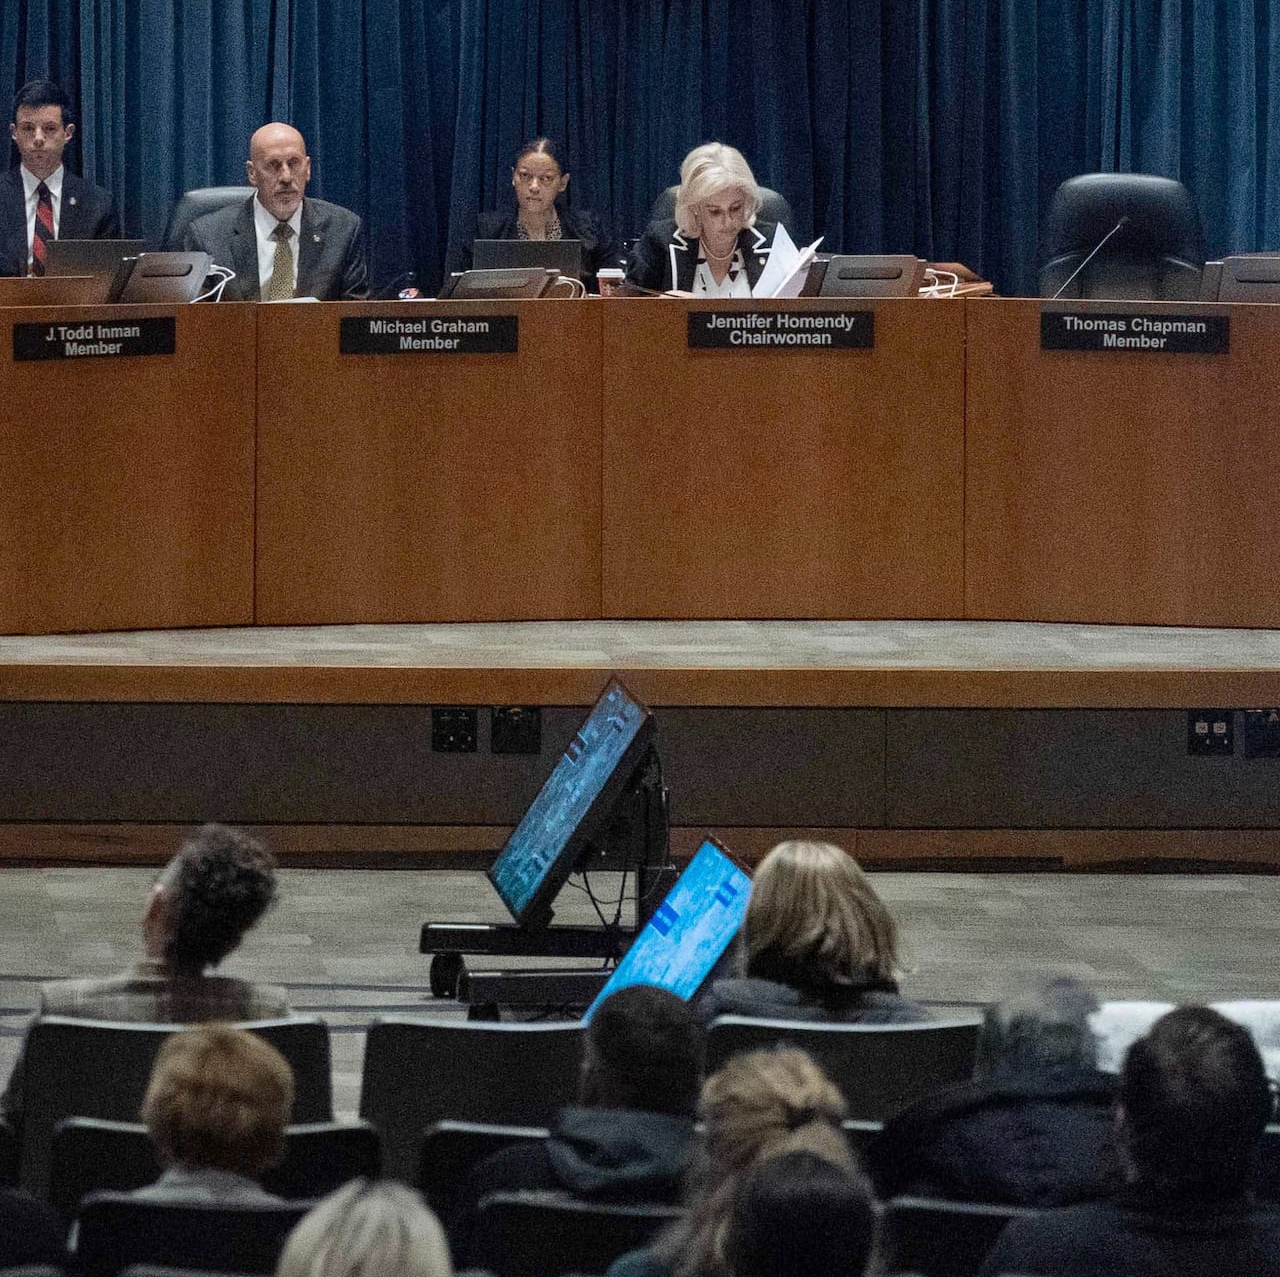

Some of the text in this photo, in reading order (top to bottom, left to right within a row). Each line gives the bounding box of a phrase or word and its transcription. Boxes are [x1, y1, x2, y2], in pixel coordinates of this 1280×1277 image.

[369, 320, 490, 334] Michael Graham
[707, 314, 855, 331] Jennifer Homendy
[1063, 316, 1206, 335] Thomas Chapman
[45, 326, 140, 341] J. Todd Inman
[730, 330, 832, 345] Chairwoman
[1103, 333, 1167, 348] Member
[65, 341, 122, 356] Member
[399, 336, 460, 350] Member
